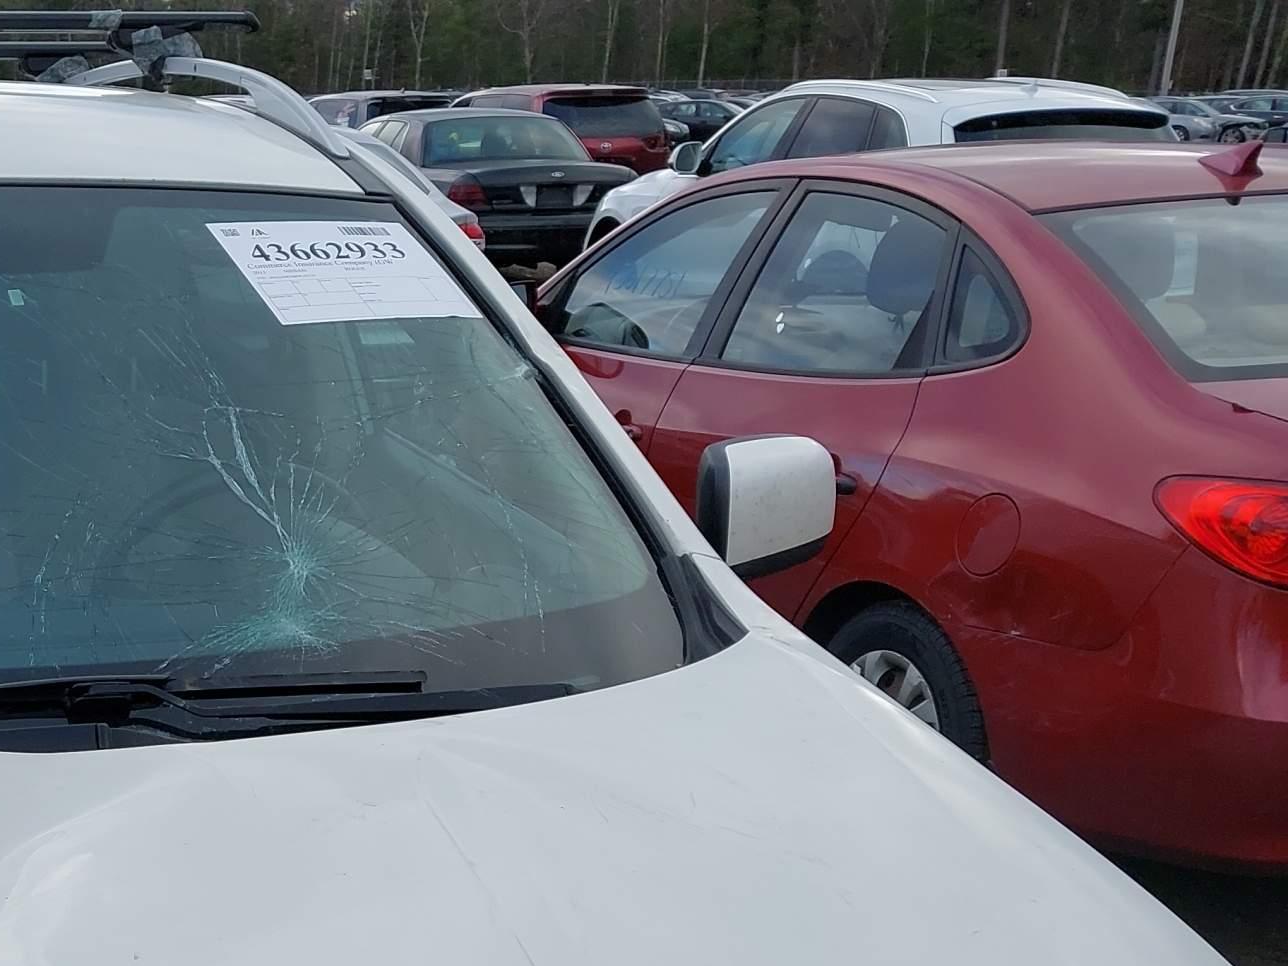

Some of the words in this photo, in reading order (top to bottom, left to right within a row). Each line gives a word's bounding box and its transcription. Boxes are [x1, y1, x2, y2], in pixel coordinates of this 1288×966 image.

[251, 242, 406, 261] 43662933
[294, 260, 333, 268] Insurance
[334, 259, 373, 267] Company
